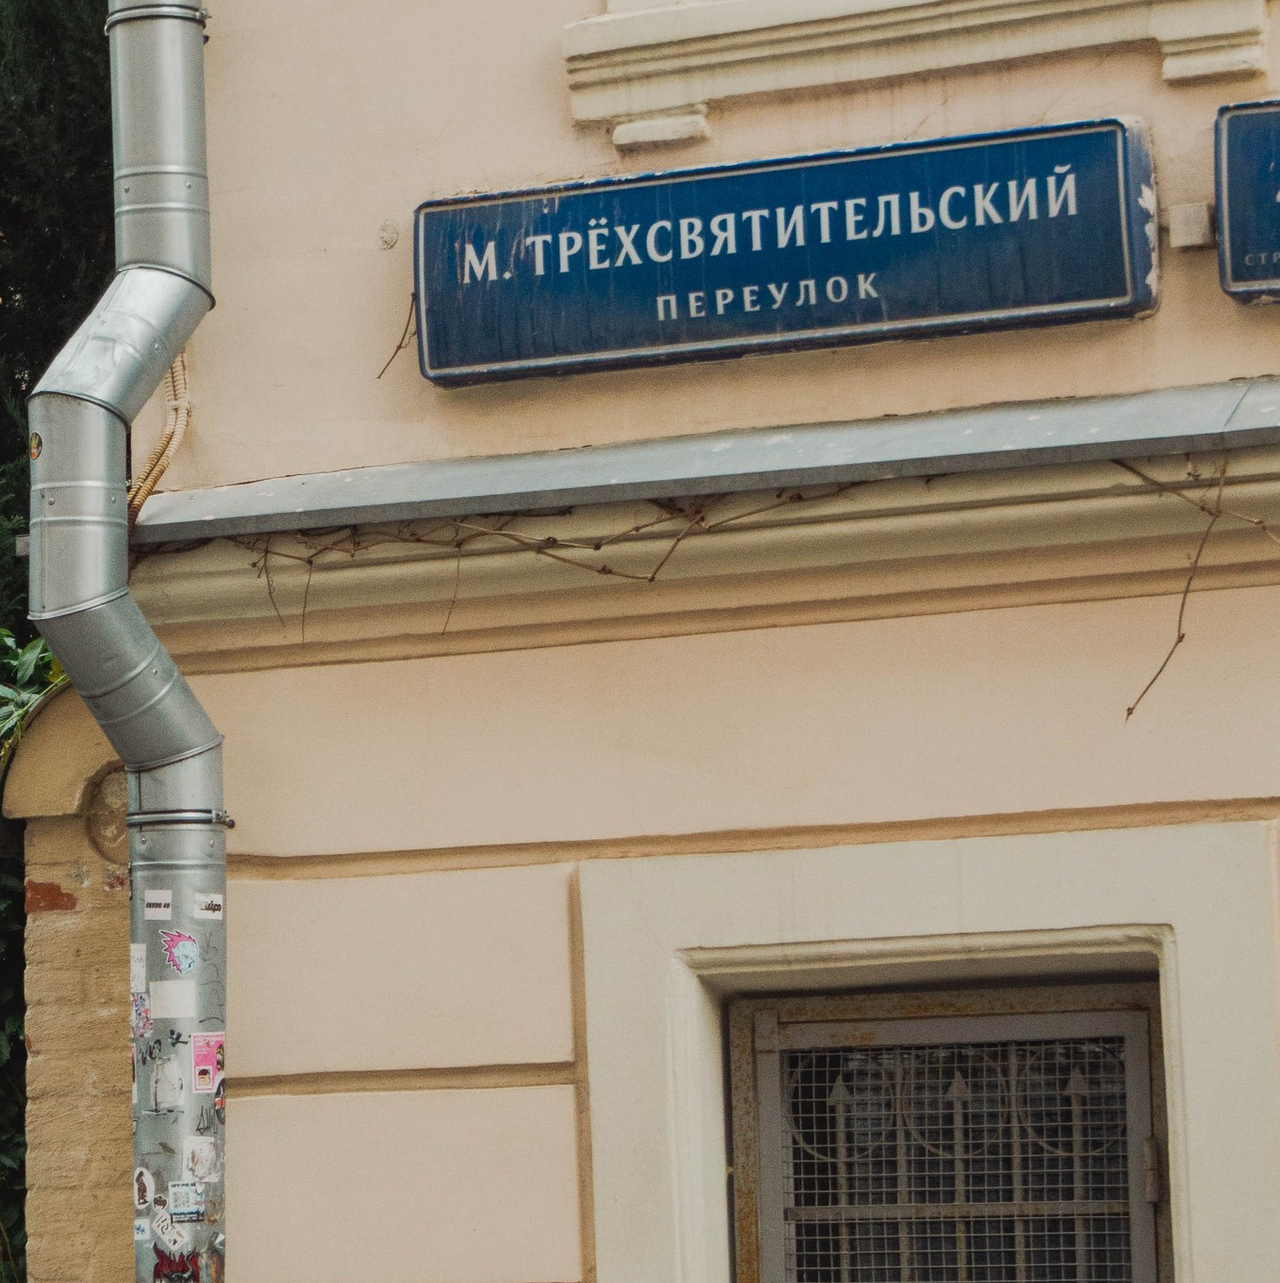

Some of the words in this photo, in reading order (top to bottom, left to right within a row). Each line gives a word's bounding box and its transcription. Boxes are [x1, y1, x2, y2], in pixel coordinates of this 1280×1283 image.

[463, 240, 513, 284] М.
[525, 164, 1078, 277] ТРЁХСВЯТИТЕЛЬСКИЙ
[656, 272, 879, 322] ПЕРЕУЛОК
